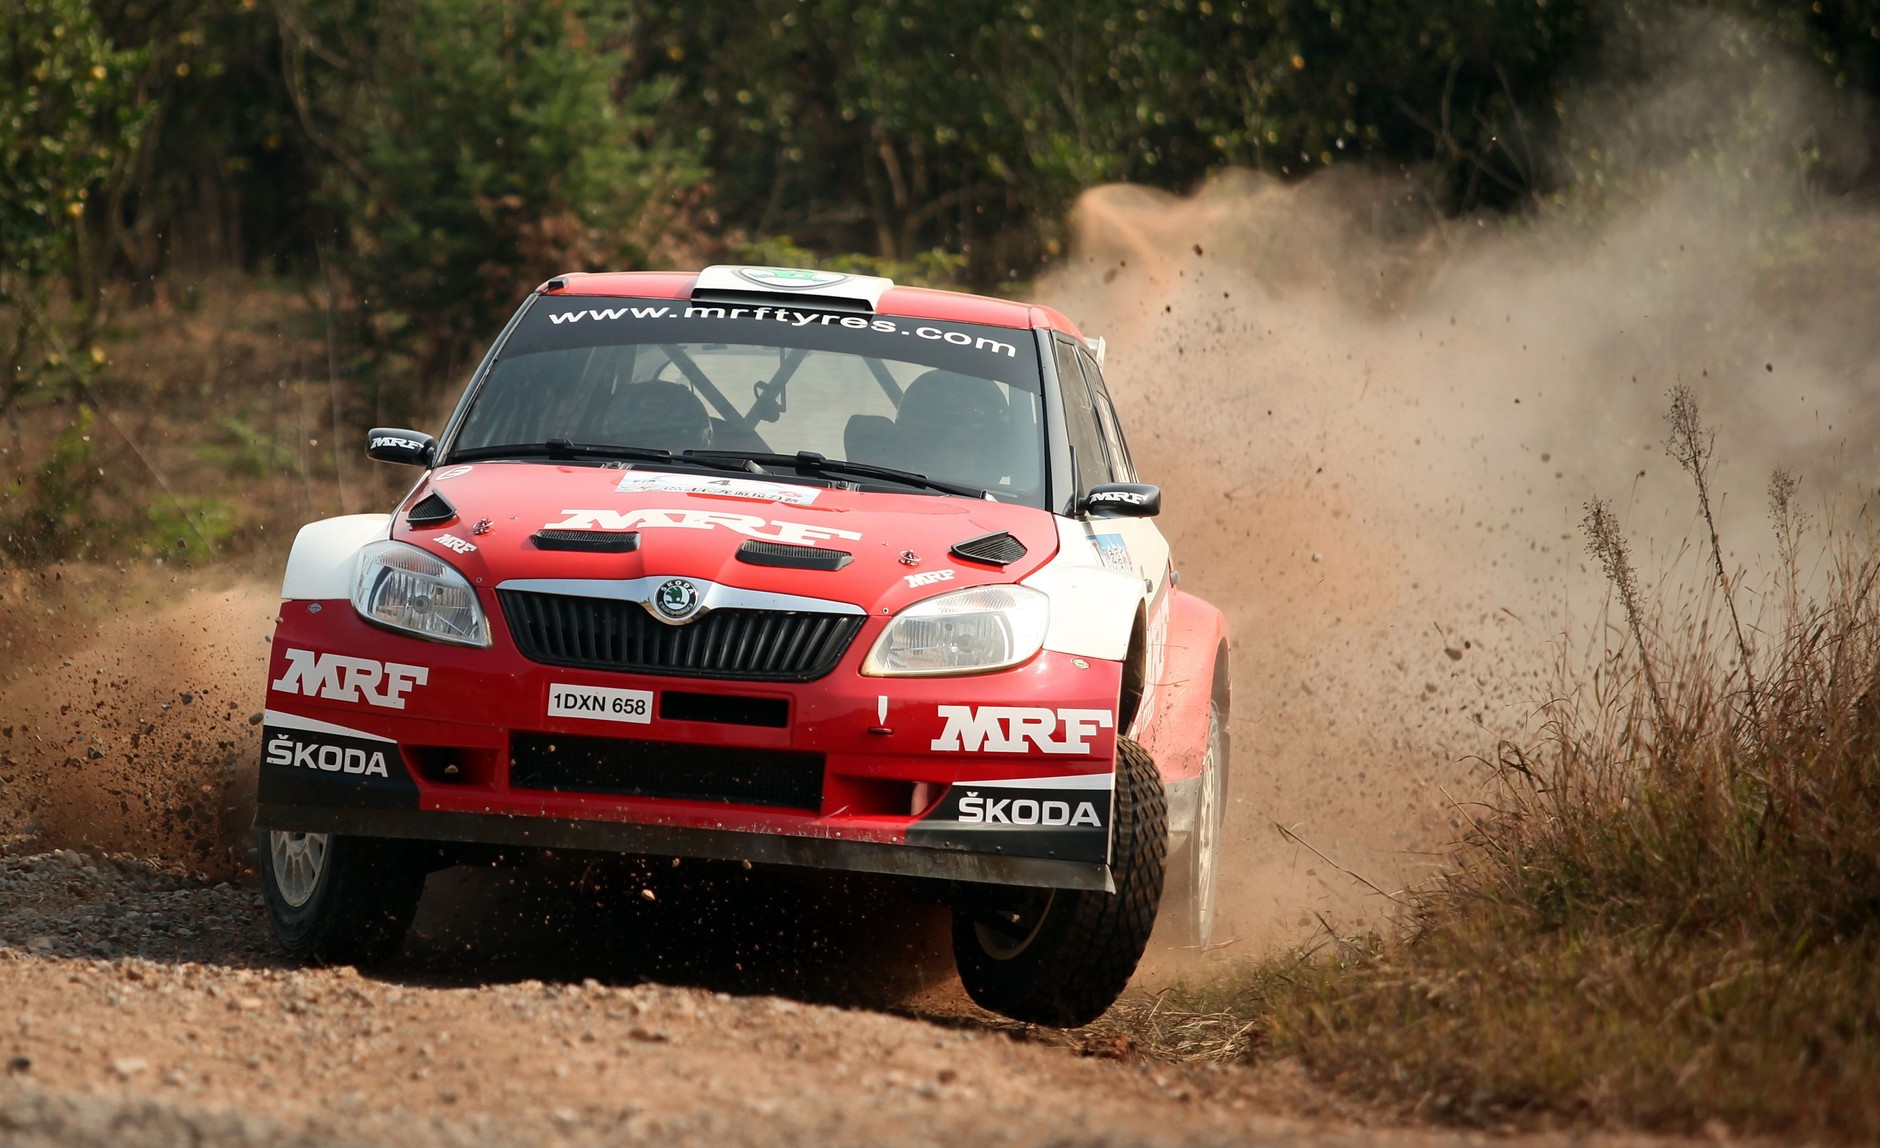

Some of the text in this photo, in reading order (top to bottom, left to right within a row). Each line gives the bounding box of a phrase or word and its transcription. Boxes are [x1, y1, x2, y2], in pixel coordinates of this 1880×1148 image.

[548, 306, 1017, 358] www.mrftyres.com
[370, 437, 425, 450] MRF
[707, 479, 731, 487] 4
[1089, 491, 1147, 505] MRF
[544, 508, 862, 546] MRF
[433, 533, 477, 554] MRF
[903, 569, 955, 588] MRF
[272, 647, 429, 710] MRF
[554, 692, 646, 715] 1DXN 658
[930, 705, 1113, 754] MRF
[266, 733, 389, 778] ŠKODA
[958, 791, 1102, 827] ŠKODA
